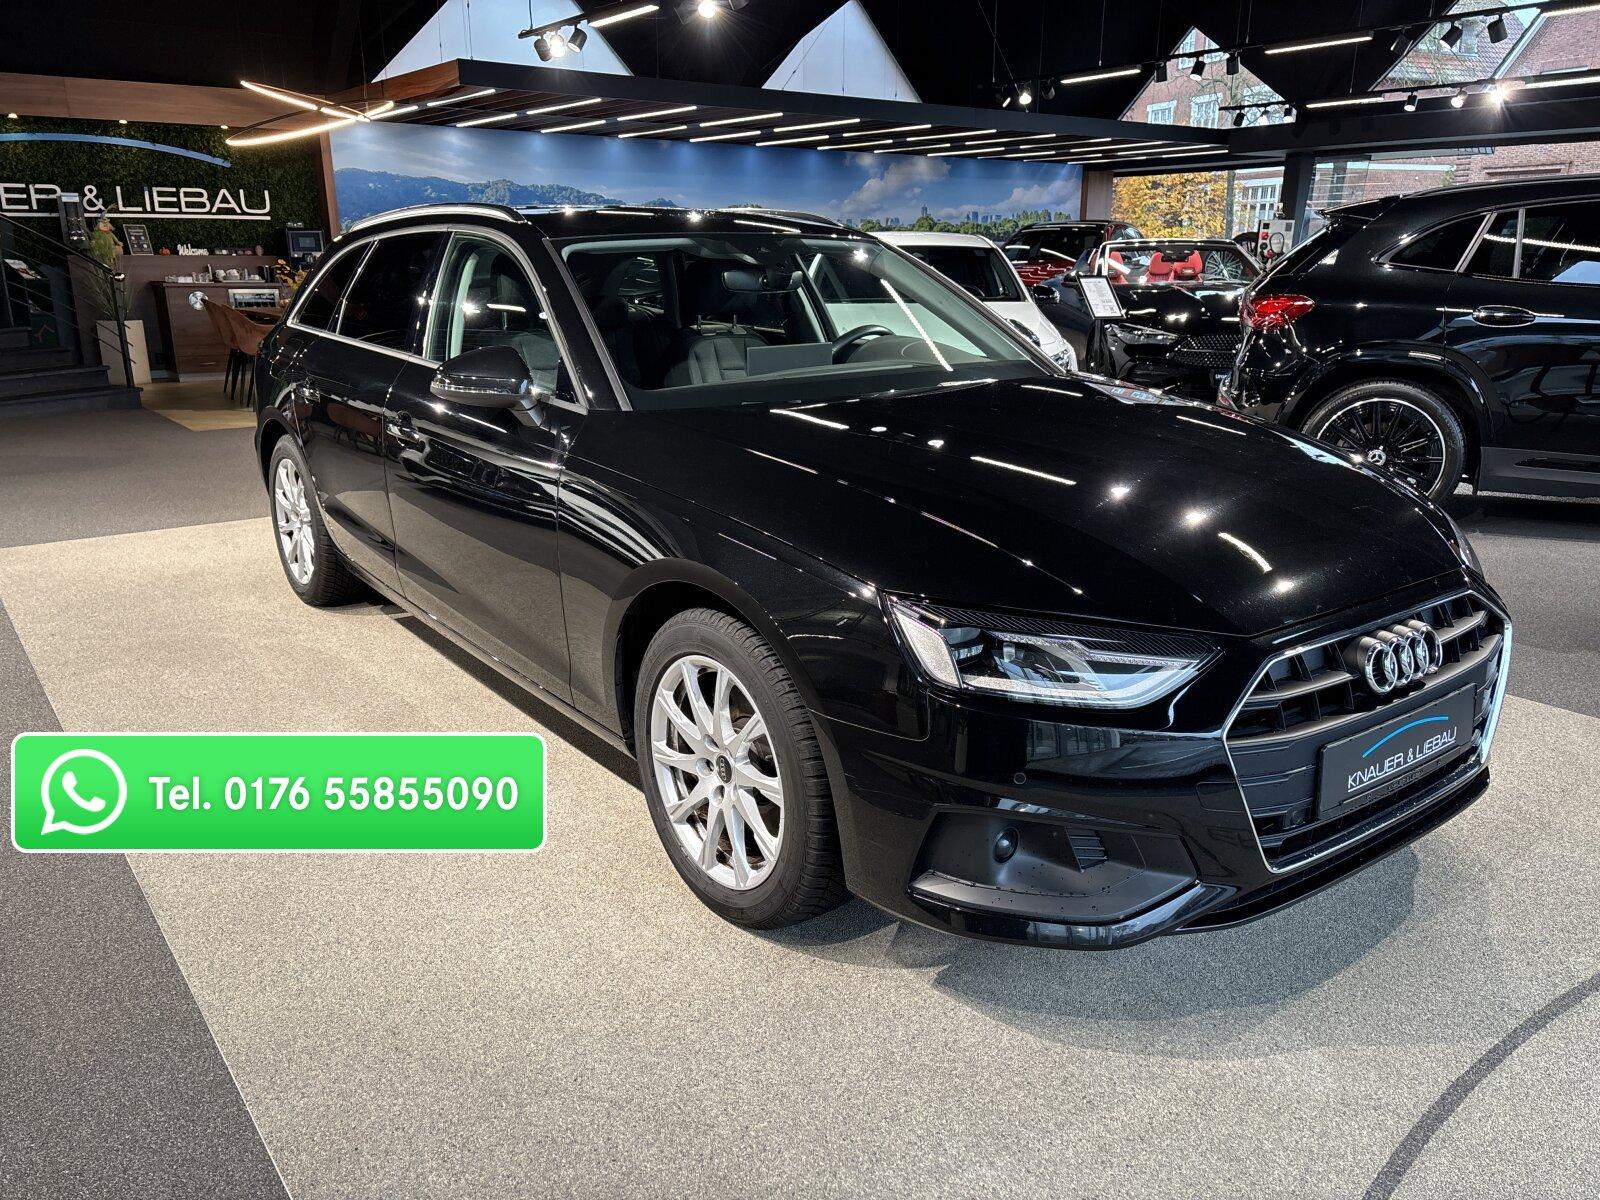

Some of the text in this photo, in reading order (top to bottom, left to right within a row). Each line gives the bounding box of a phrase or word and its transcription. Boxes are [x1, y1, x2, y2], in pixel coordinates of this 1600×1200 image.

[83, 184, 106, 211] &
[115, 185, 271, 214] LIEBAU
[177, 243, 209, 256] Welcome
[1347, 753, 1404, 789] KNAUER
[1407, 748, 1414, 763] &
[1416, 726, 1457, 759] LIEBAU
